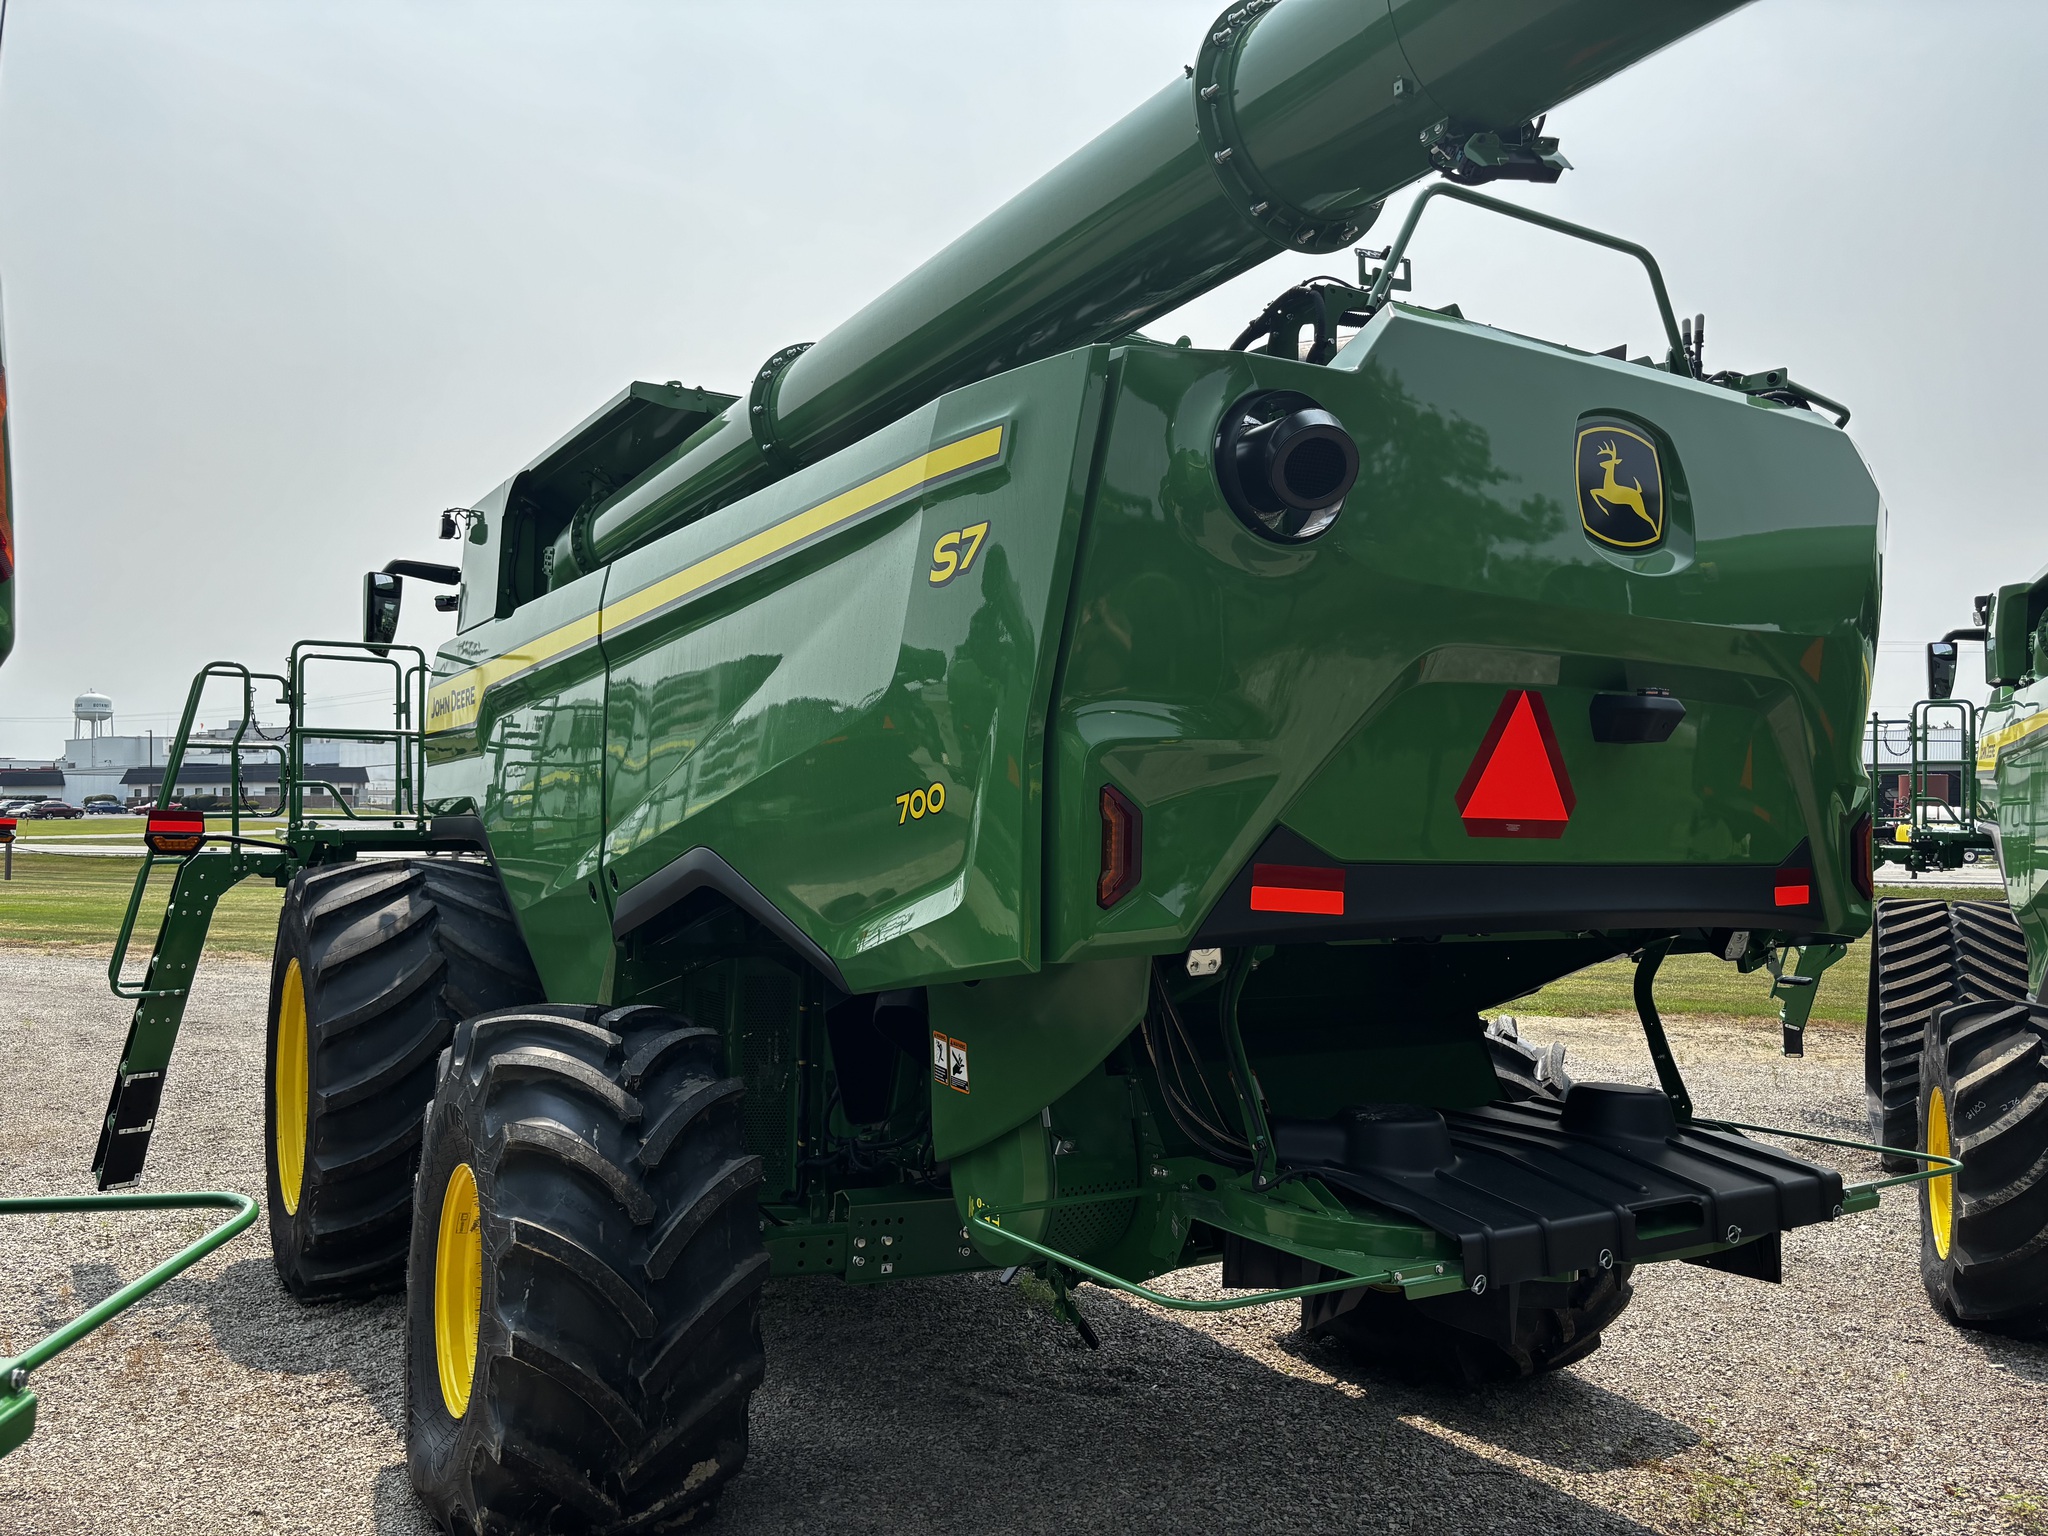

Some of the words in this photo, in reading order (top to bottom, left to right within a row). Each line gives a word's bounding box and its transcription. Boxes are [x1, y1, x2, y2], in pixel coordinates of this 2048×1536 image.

[928, 519, 991, 588] S7
[431, 696, 450, 718] JOHN
[451, 685, 476, 712] DEERE
[895, 781, 946, 826] 700
